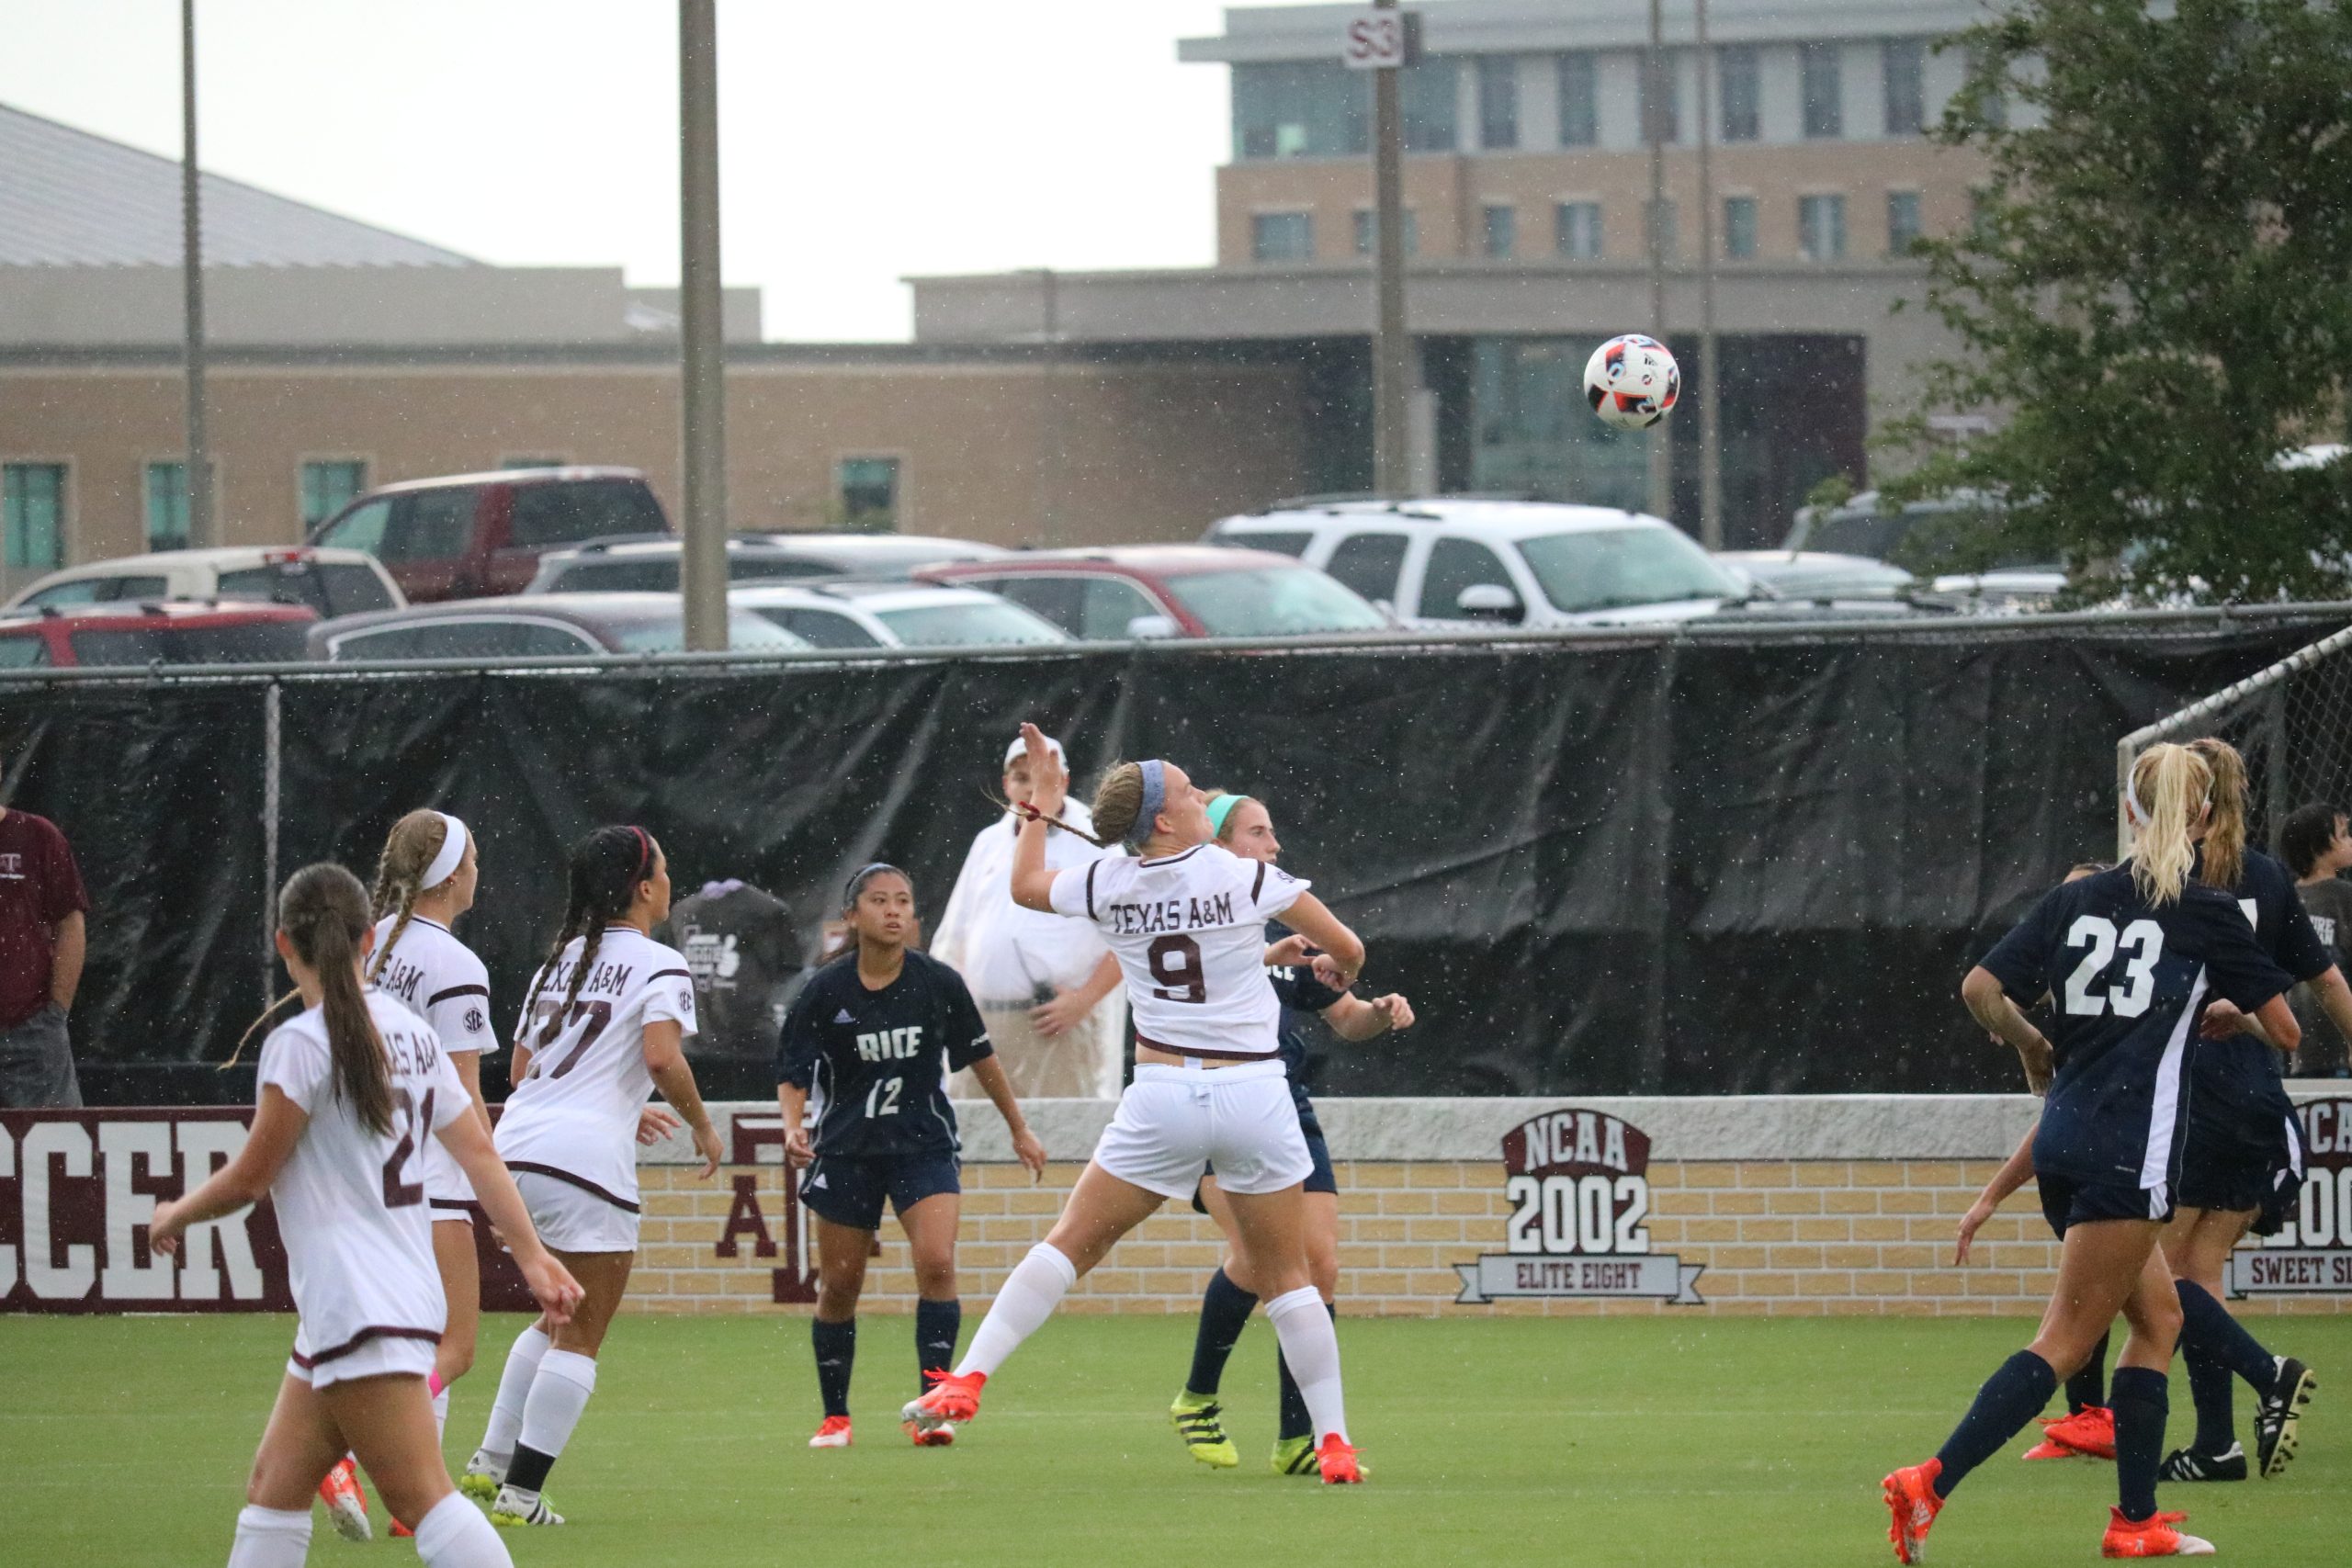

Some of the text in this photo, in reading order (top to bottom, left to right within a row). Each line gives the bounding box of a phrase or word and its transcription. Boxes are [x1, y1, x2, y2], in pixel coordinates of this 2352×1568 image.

[1348, 18, 1397, 60] S3
[1110, 892, 1235, 935] TEXAS A&M
[588, 961, 633, 997] A&M
[1148, 933, 1206, 1004] 9
[2064, 915, 2165, 1019] 23
[465, 1010, 483, 1032] SEC
[531, 998, 612, 1080] 27
[855, 1025, 923, 1063] RICE
[865, 1077, 904, 1119] 12
[1523, 1111, 1629, 1173] NCAA
[0, 1121, 264, 1300] CER
[1506, 1175, 1650, 1254] 2002
[1517, 1262, 1642, 1290] ELITE EIGHT
[2252, 1256, 2325, 1284] SWEET
